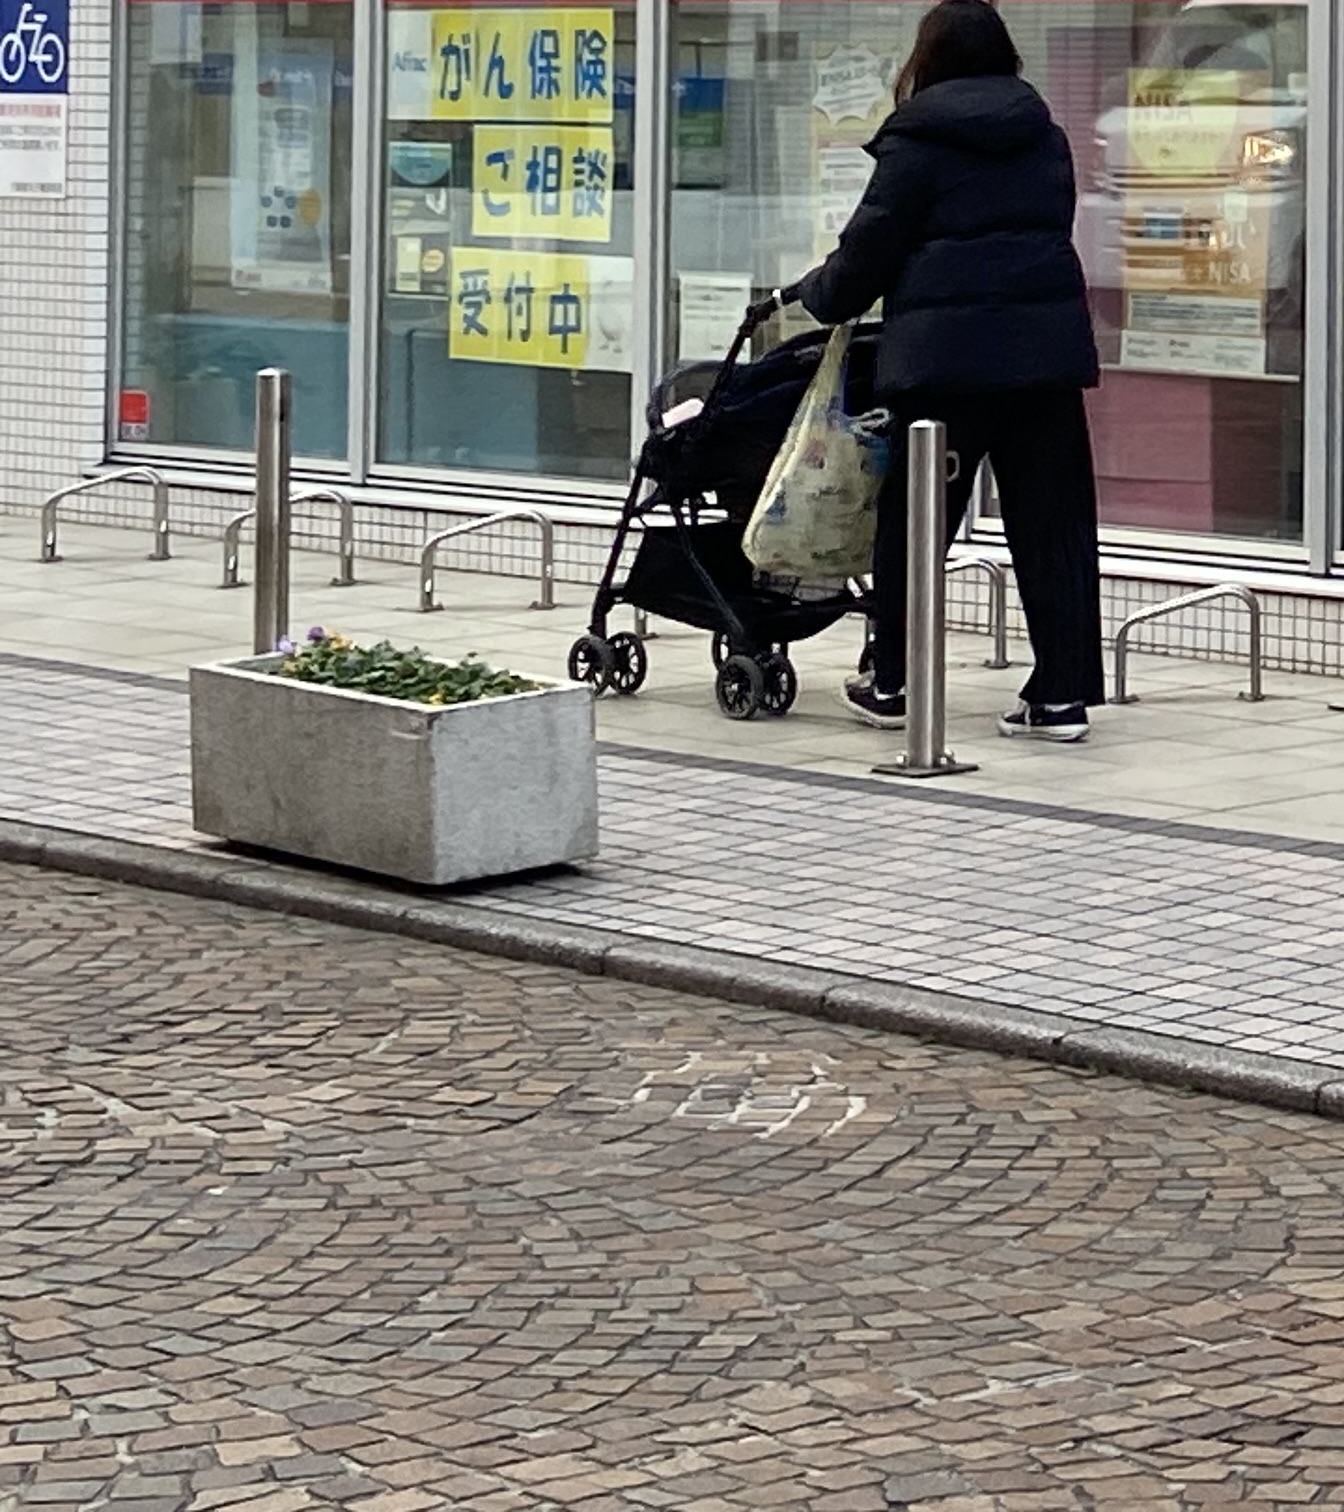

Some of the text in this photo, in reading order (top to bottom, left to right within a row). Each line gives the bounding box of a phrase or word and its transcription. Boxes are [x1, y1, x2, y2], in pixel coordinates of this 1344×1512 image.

[440, 29, 607, 102] がん保険
[481, 145, 607, 219] ご相談
[457, 267, 583, 353] 受付中
